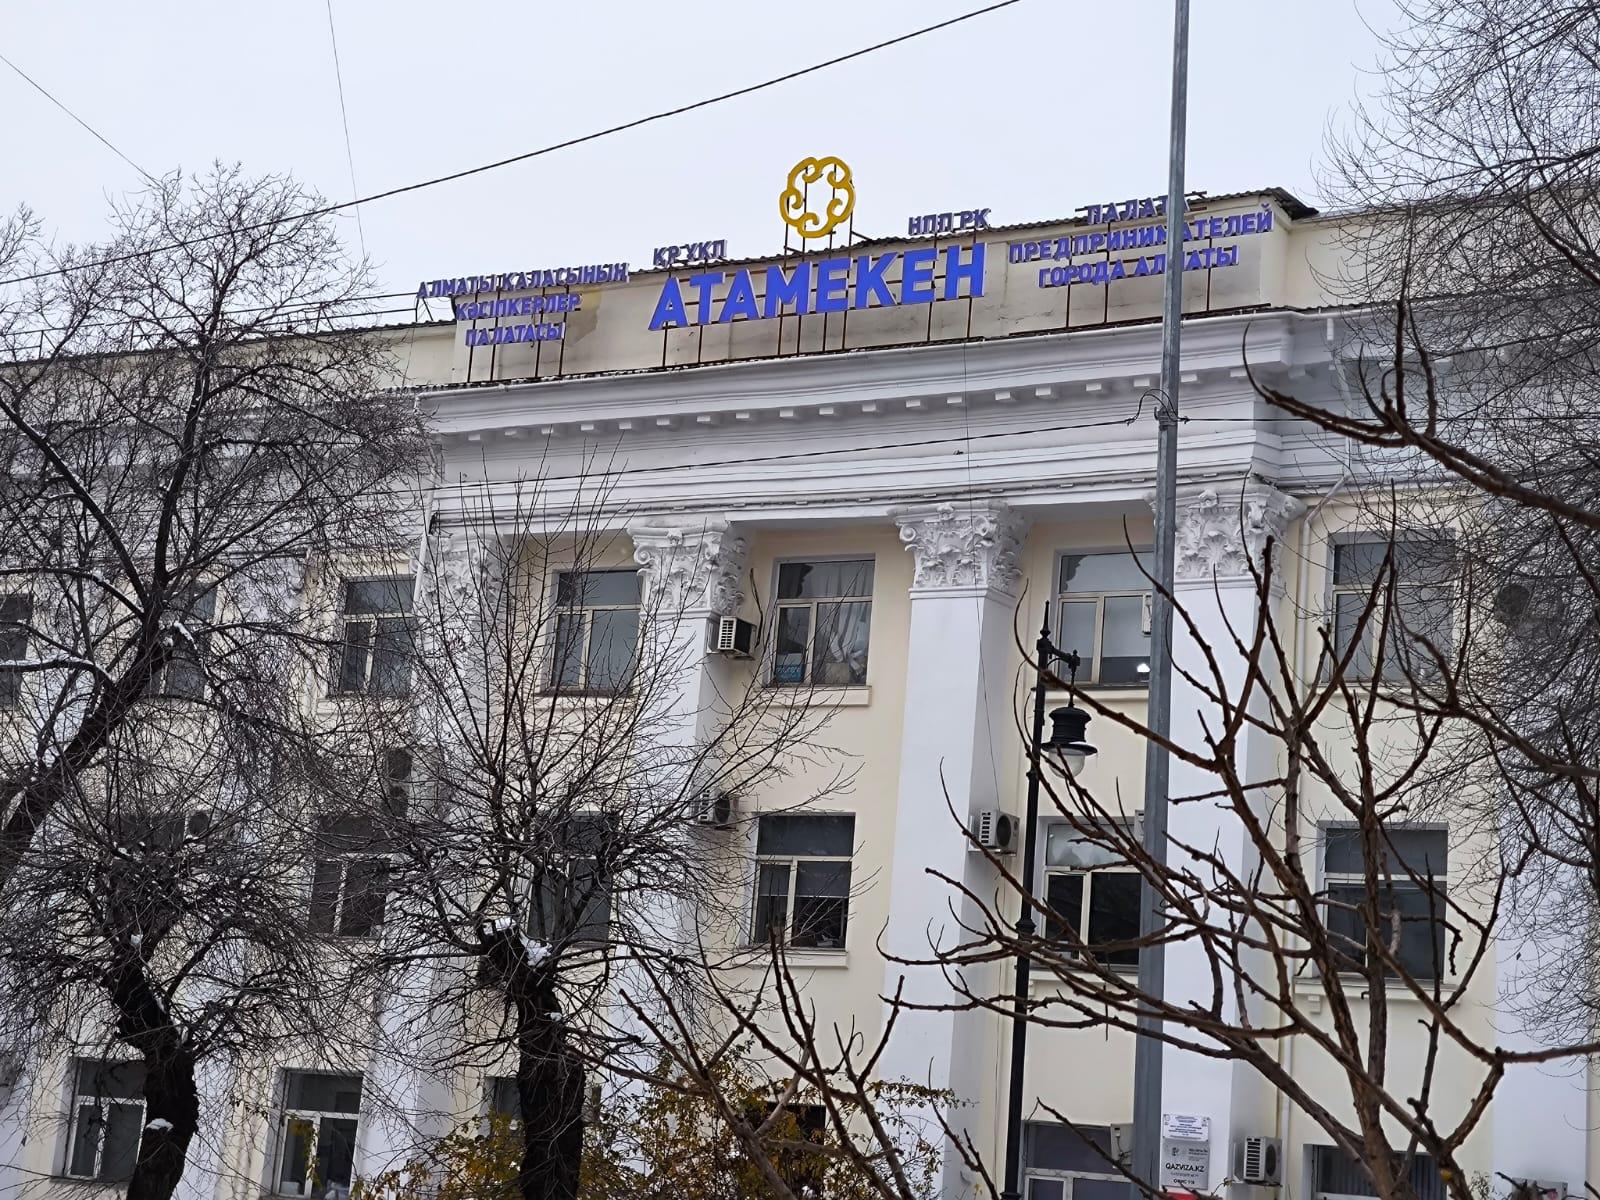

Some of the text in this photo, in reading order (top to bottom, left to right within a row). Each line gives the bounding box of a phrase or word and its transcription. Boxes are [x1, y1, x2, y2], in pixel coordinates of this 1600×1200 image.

[908, 208, 991, 236] НПП РК
[1087, 194, 1190, 225] ПАЛАТ
[1039, 245, 1240, 288] ГОРОДА АЛАТЫ
[417, 273, 498, 299] АЛМАТЫ
[648, 242, 987, 331] АТАМЕКЕН
[456, 293, 582, 321] КӘСІПКЕРЛЕР
[465, 322, 566, 347] ПАЛАТАСЫ
[1165, 1162, 1205, 1173] QAZVIZA.KZ
